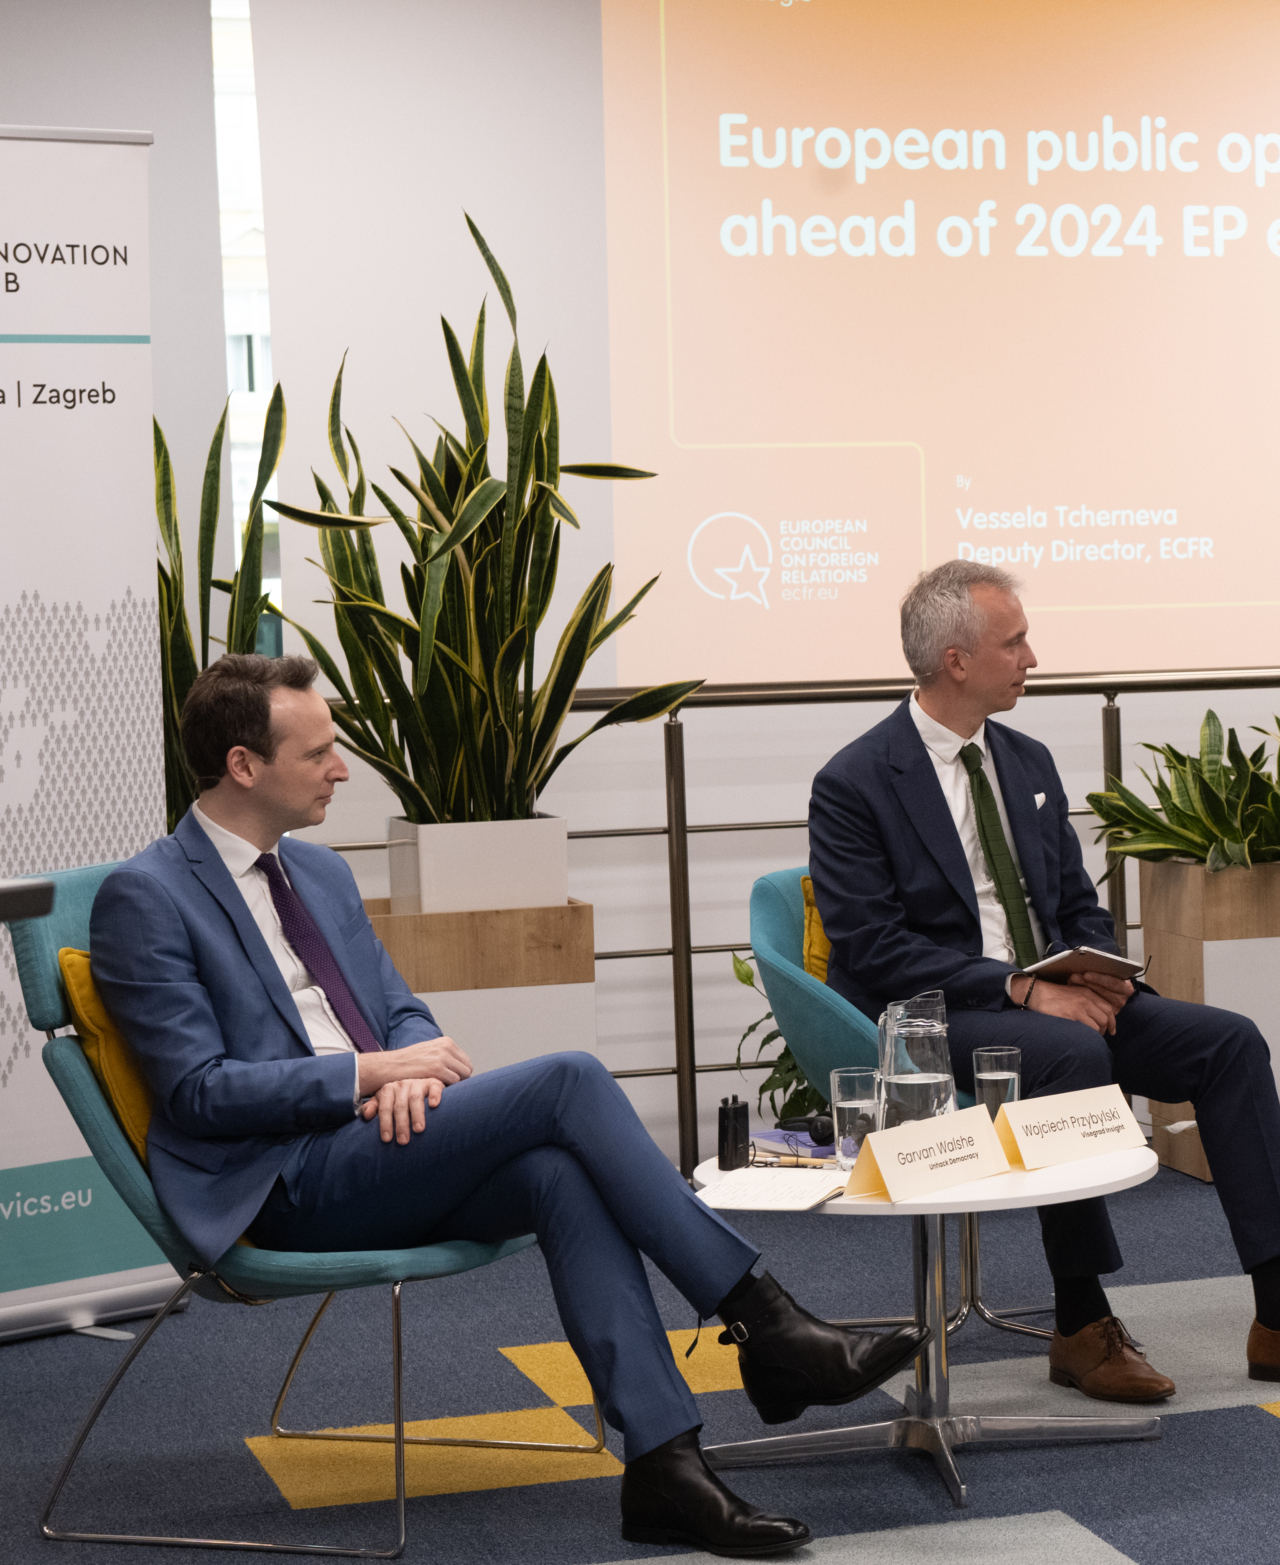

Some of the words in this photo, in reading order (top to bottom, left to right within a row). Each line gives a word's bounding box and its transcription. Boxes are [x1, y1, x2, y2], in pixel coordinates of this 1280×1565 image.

[718, 113, 1007, 184] European
[1027, 114, 1200, 186] public
[719, 198, 916, 257] ahead
[936, 200, 998, 257] of
[1015, 203, 1164, 257] 2024
[1183, 205, 1249, 257] EP
[32, 381, 116, 409] Zagreb
[956, 475, 971, 491] By
[780, 518, 867, 535] EUROPEAN
[955, 504, 1048, 529] Vessela
[1053, 504, 1178, 528] Tcherneva
[780, 535, 852, 552] COUNCIL
[957, 540, 1045, 569] Deputy
[1050, 538, 1152, 564] Director,
[1159, 536, 1214, 559] ECFR
[781, 553, 806, 568] ON
[809, 551, 879, 567] FOREIGN
[781, 568, 868, 584] RELATIONS
[782, 585, 838, 600] ecfr.eu
[1021, 1119, 1070, 1140] Wojciech
[1070, 1107, 1121, 1132] Przybylski
[1080, 1127, 1106, 1139] Visegrad
[1105, 1123, 1126, 1137] Insight
[897, 1145, 937, 1166] Garvan
[936, 1134, 975, 1155] Walshe
[928, 1160, 950, 1171] Unhack
[950, 1151, 979, 1166] Democracy
[0, 1188, 92, 1220] vics.eu
